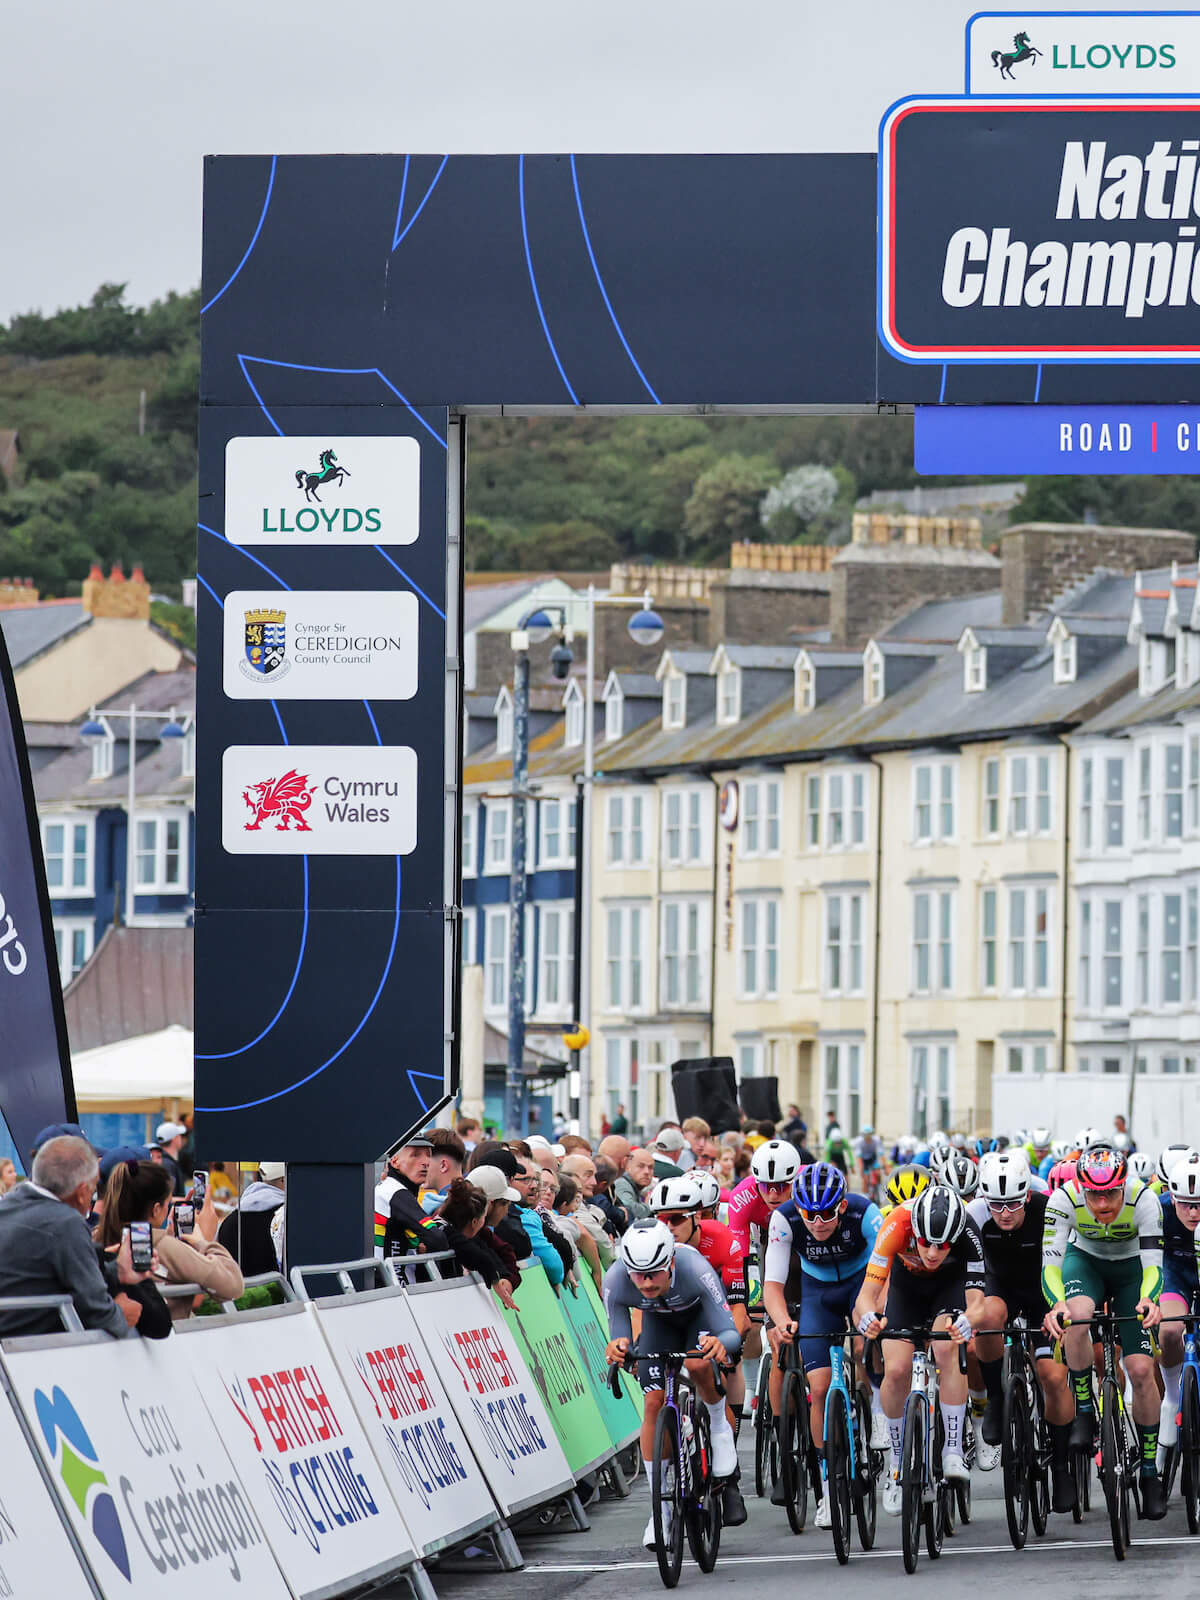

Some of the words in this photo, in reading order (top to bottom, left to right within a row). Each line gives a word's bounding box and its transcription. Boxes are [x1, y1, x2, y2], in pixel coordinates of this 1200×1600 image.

[1052, 44, 1177, 69] LLOYDS
[1060, 423, 1134, 452] ROAD
[263, 508, 382, 532] LLOYDS
[295, 622, 332, 634] Cyngor
[334, 622, 346, 633] Sir
[295, 636, 401, 652] CEREDIGION
[295, 654, 330, 666] County
[333, 654, 371, 664] Council
[324, 776, 399, 802] Cymru
[325, 803, 390, 823] Wales
[365, 1342, 437, 1421] BRITISH
[455, 1326, 519, 1395] BRITISH
[120, 1389, 183, 1458] Caru
[247, 1365, 344, 1453] BRITISH
[486, 1392, 547, 1461] CYCLING
[400, 1417, 468, 1494] CYCLING
[289, 1446, 380, 1535] CYCLING
[119, 1463, 262, 1583] Ceredigion
